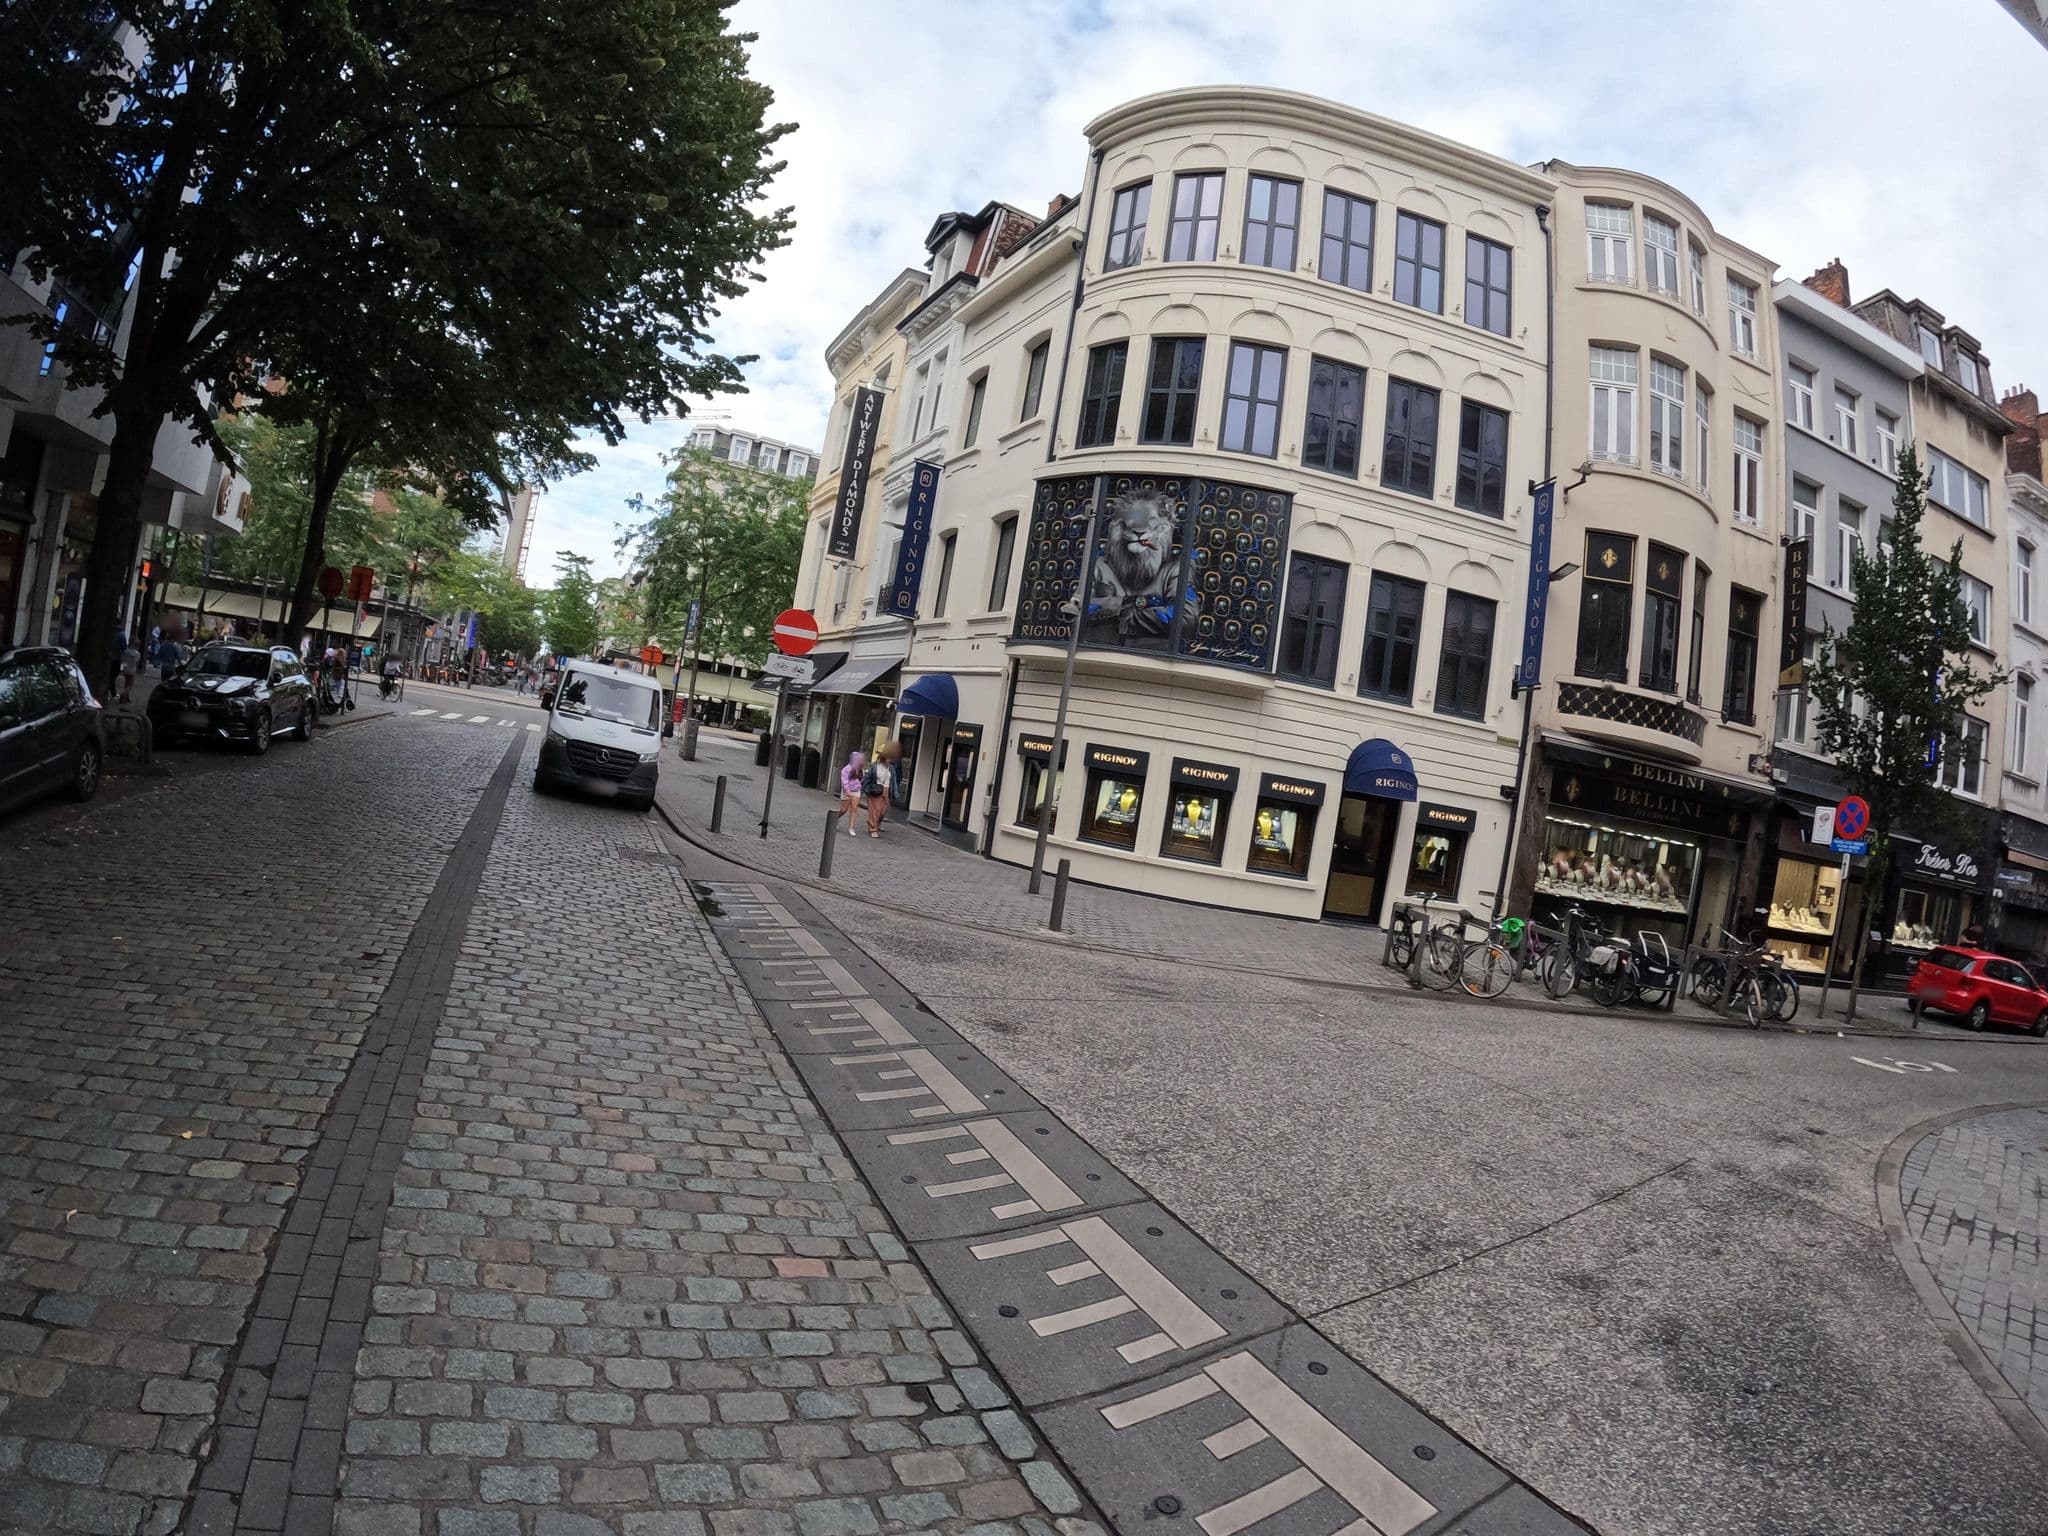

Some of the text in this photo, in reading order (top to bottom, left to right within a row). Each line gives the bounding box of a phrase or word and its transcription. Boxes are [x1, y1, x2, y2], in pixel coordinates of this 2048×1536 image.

[857, 394, 875, 457] ANTWERP
[841, 460, 863, 537] DIAMONDS
[904, 492, 927, 586] RIGINOV
[1530, 523, 1546, 647] RIGINOV
[1789, 551, 1802, 661] BELLINI
[1023, 741, 1054, 752] RIGINO
[1093, 752, 1138, 766] RIGINOV
[1181, 767, 1229, 782] RIGINOV
[1271, 782, 1315, 797] RIGINOV
[1632, 764, 1705, 792] BELLINI
[1428, 810, 1467, 824] RIGINOV
[1615, 786, 1701, 818] BELLINI
